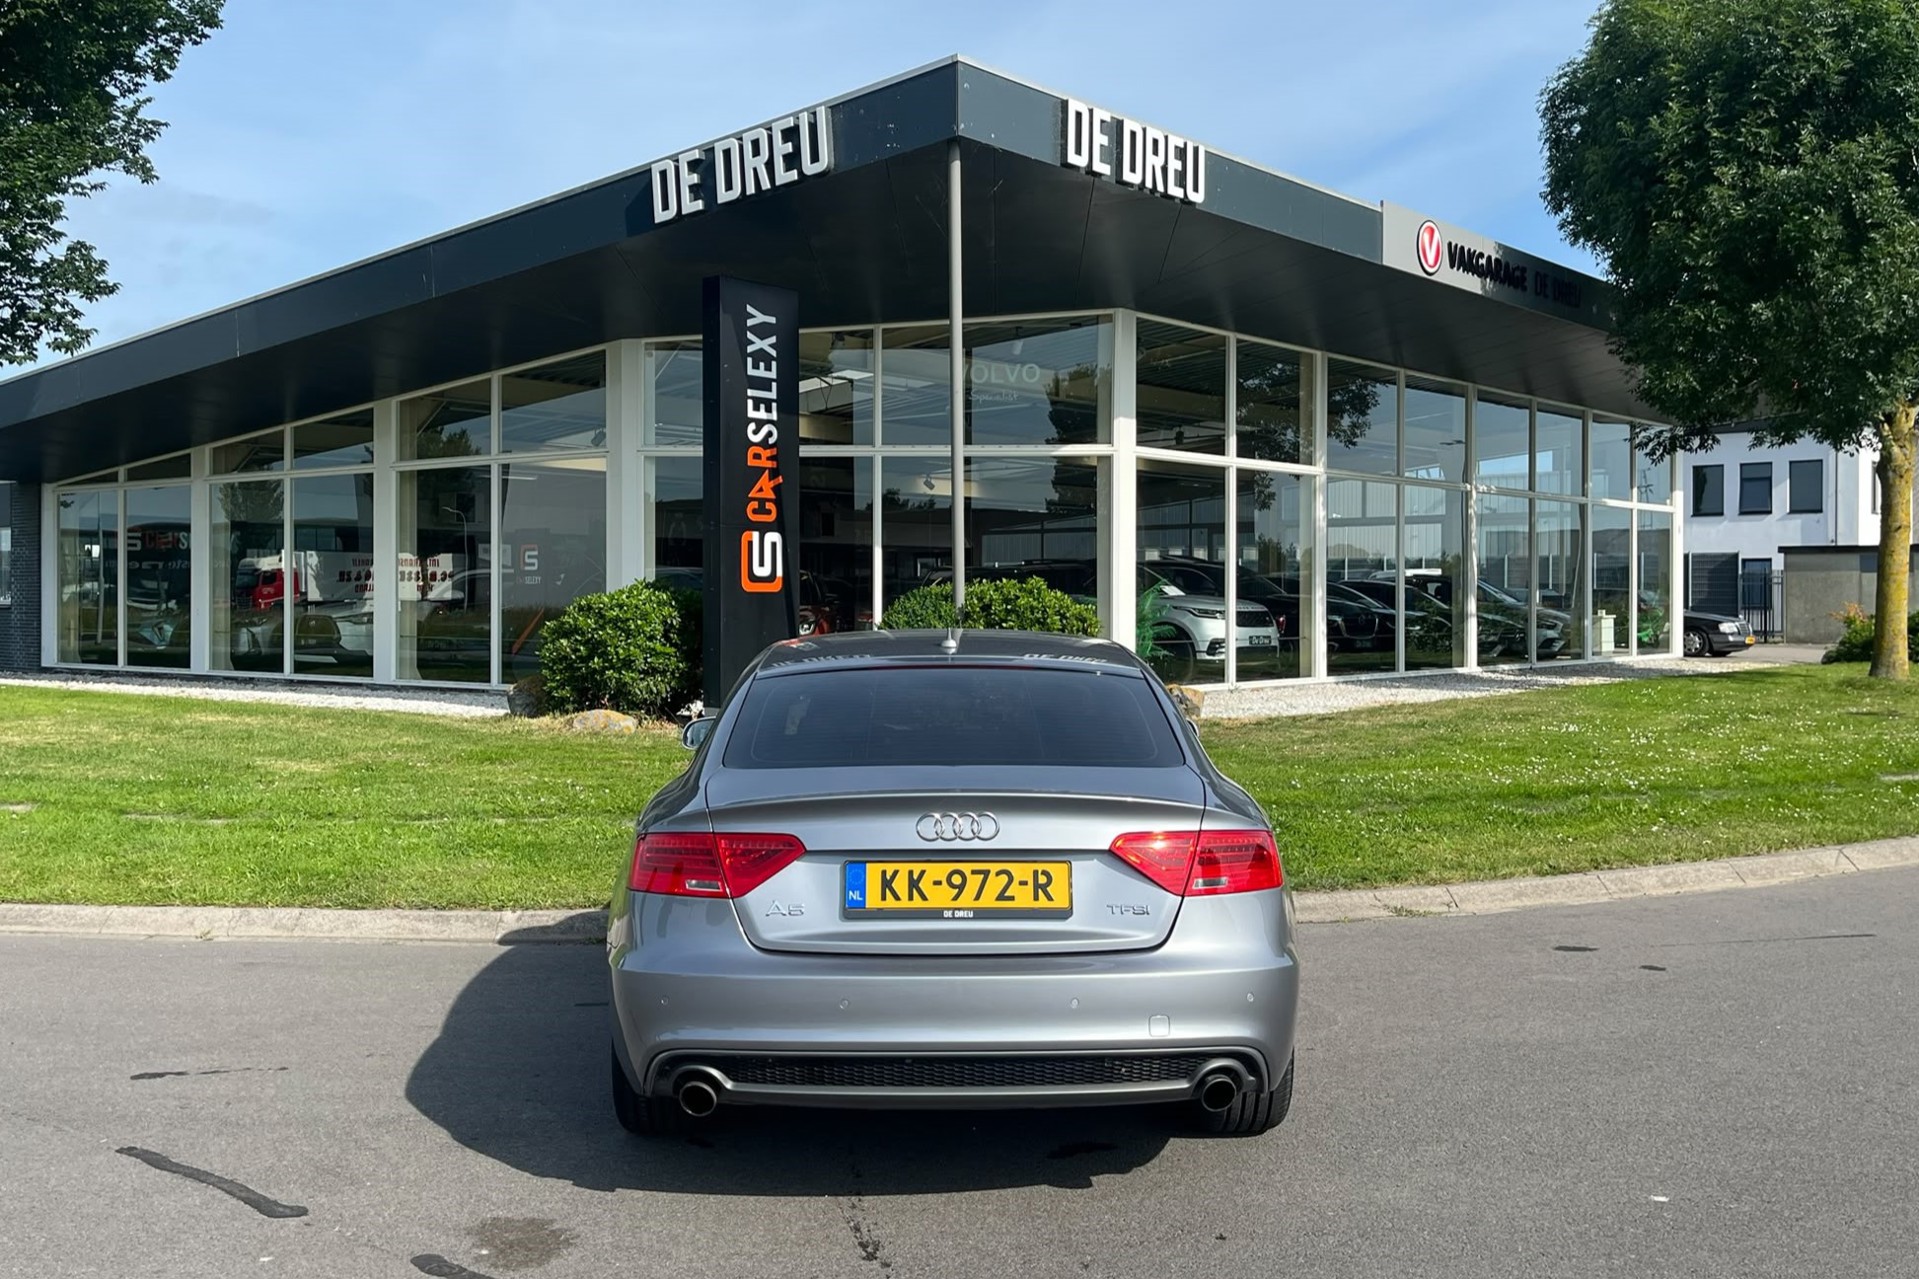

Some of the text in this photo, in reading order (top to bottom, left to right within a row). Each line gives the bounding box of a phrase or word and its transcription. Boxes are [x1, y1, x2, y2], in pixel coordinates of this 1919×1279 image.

[651, 105, 831, 224] DE DREU
[1066, 98, 1206, 204] DE DREU
[1447, 240, 1528, 291] VAKGARAGE
[746, 304, 783, 522] CARSELEXY
[848, 890, 863, 901] NL
[880, 868, 1054, 902] KK-972-R
[765, 900, 805, 917] A5
[943, 910, 974, 918] DE DREU
[1106, 904, 1150, 916] TFSI
